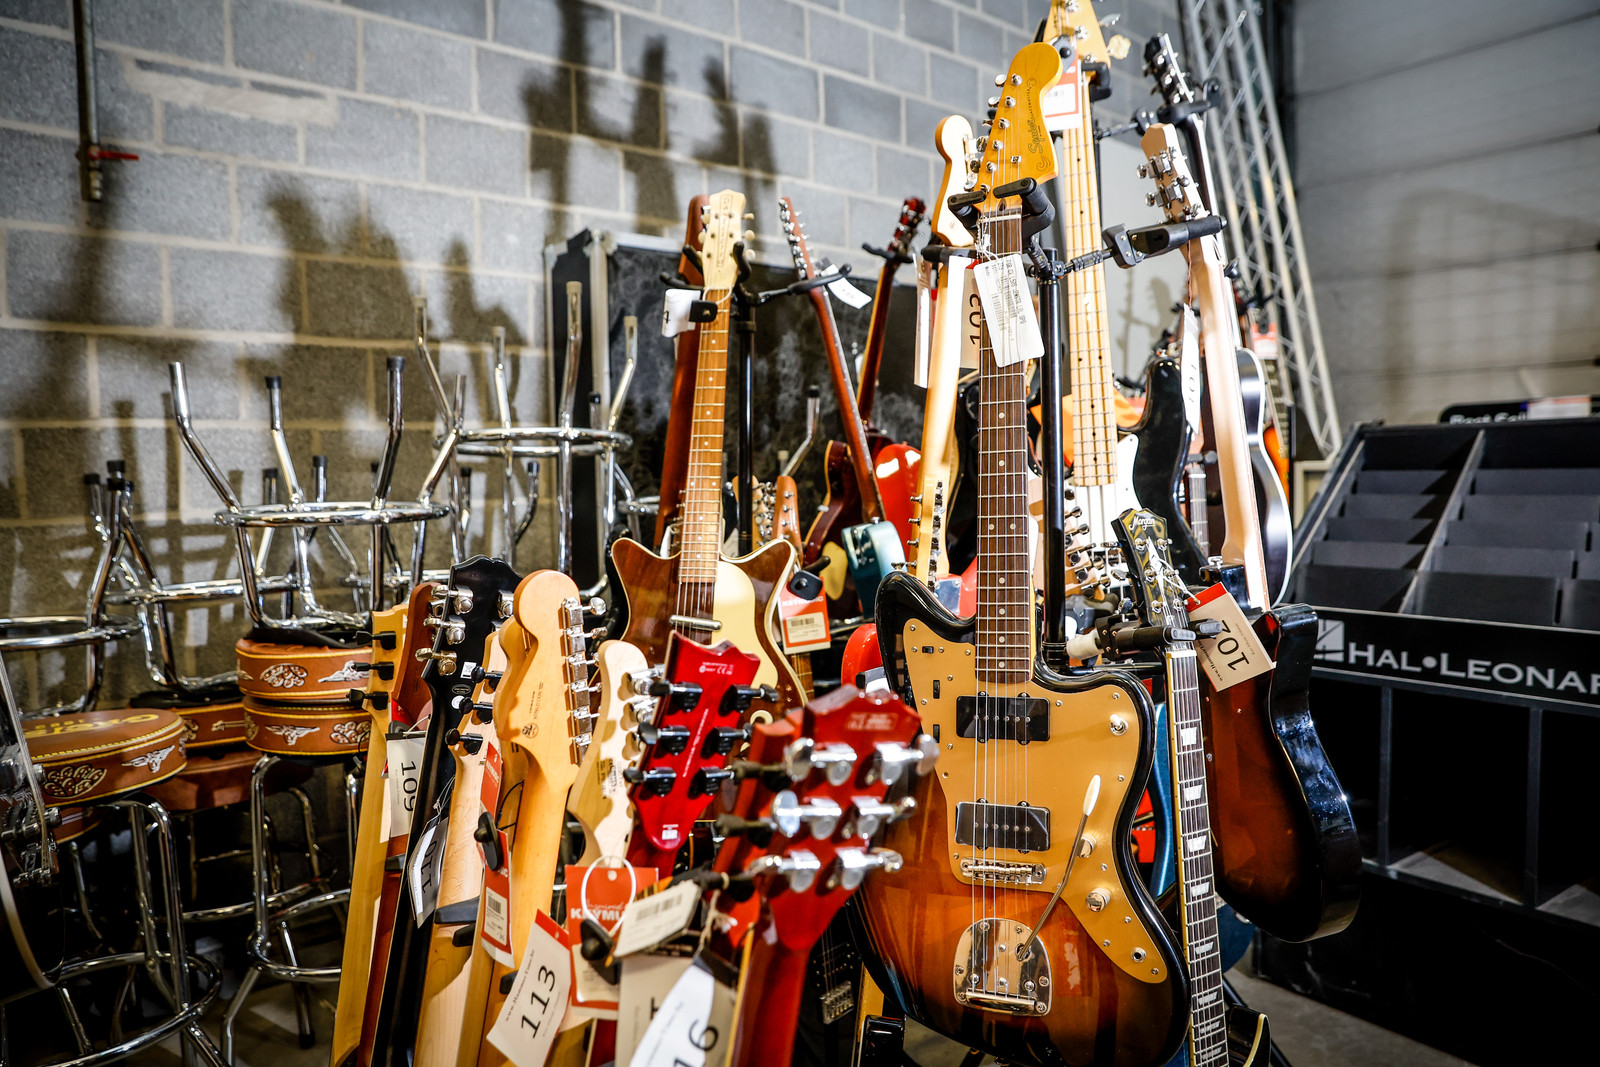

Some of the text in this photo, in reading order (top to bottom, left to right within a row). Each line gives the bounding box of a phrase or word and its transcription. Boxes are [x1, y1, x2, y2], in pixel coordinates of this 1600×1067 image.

[1129, 514, 1156, 531] Morgan
[1348, 641, 1422, 673] HAL
[400, 760, 418, 812] 109
[570, 908, 625, 923] KYMU
[521, 965, 555, 1038] 113
